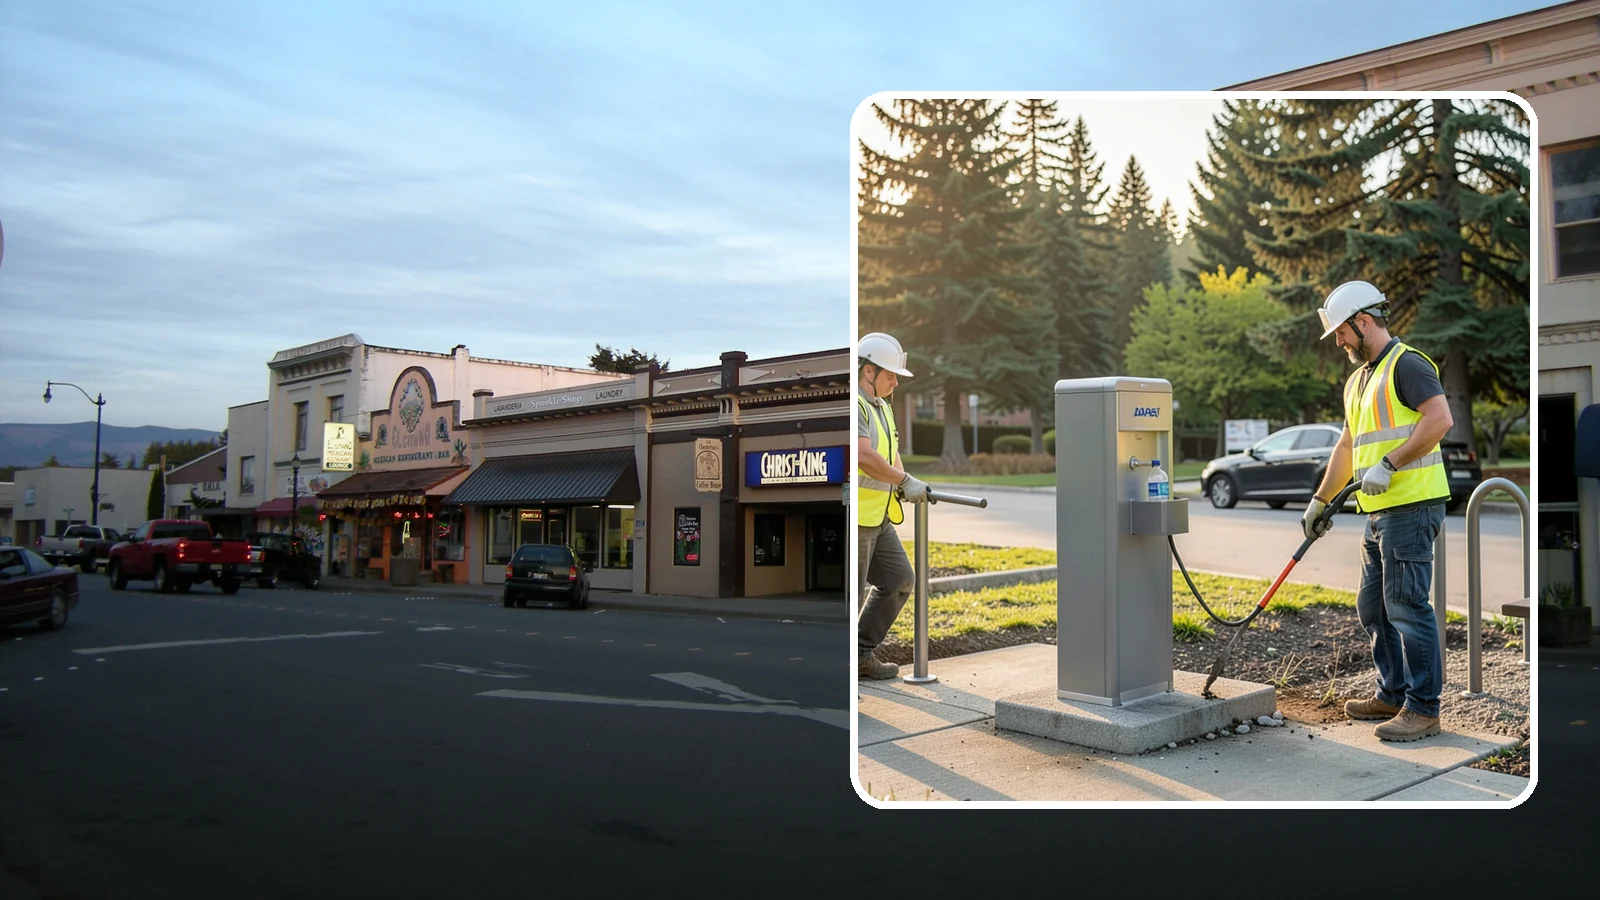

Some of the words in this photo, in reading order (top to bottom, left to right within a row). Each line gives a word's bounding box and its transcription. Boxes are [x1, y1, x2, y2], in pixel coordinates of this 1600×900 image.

[595, 389, 623, 400] LAUNDRY
[493, 402, 522, 413] LAVANDERIA
[531, 397, 561, 409] Sparkle
[562, 395, 582, 405] Shop
[373, 454, 397, 464] MEXICAN
[397, 451, 434, 462] RESTAURANT
[437, 450, 450, 459] BAR
[760, 452, 797, 478] CHRIST
[799, 450, 828, 476] KING
